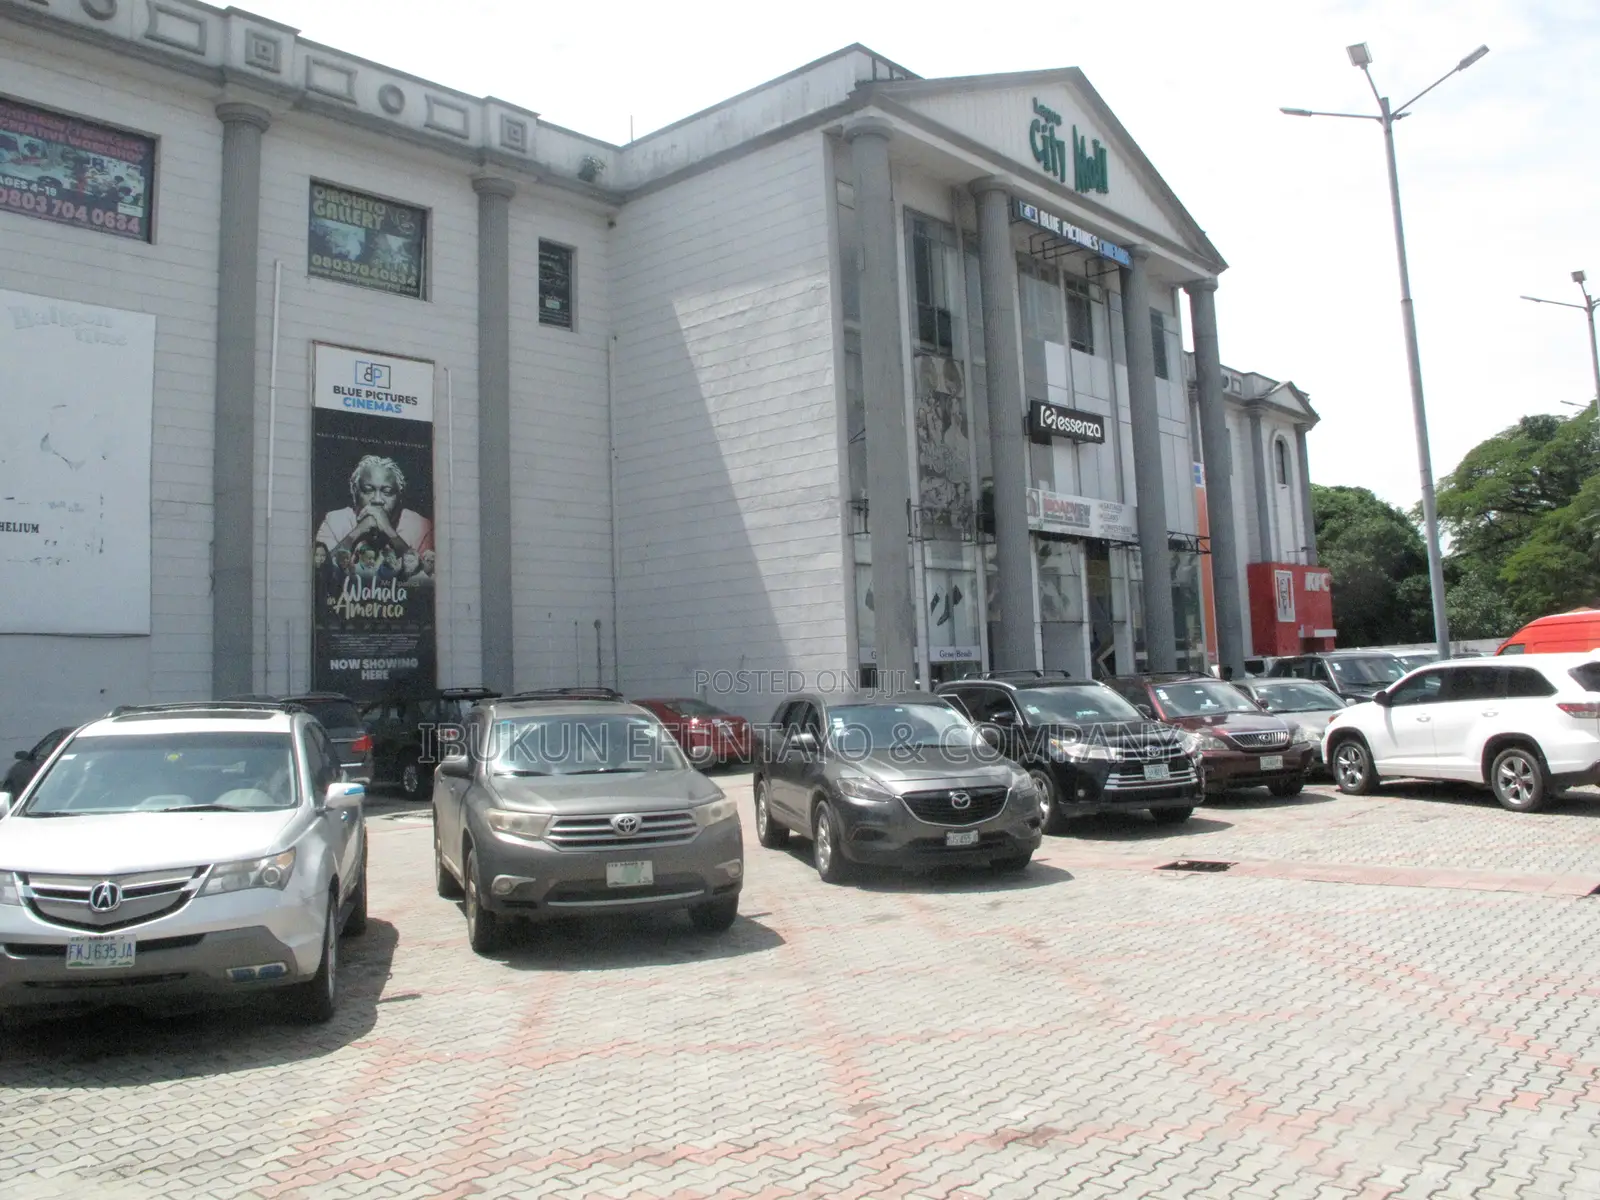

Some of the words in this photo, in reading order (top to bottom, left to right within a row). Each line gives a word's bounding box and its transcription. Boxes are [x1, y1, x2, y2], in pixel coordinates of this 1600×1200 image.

[52, 199, 88, 222] 704
[332, 385, 362, 398] BLUE
[365, 389, 418, 406] PICTURES
[343, 396, 403, 414] CINEMAS
[1057, 415, 1102, 438] essenza
[344, 574, 407, 603] Wahala
[1304, 571, 1331, 592] KFC
[327, 594, 336, 605] in
[333, 591, 404, 620] America
[330, 658, 360, 670] NOW
[361, 658, 419, 669] SHOWING
[361, 670, 389, 680] HERE
